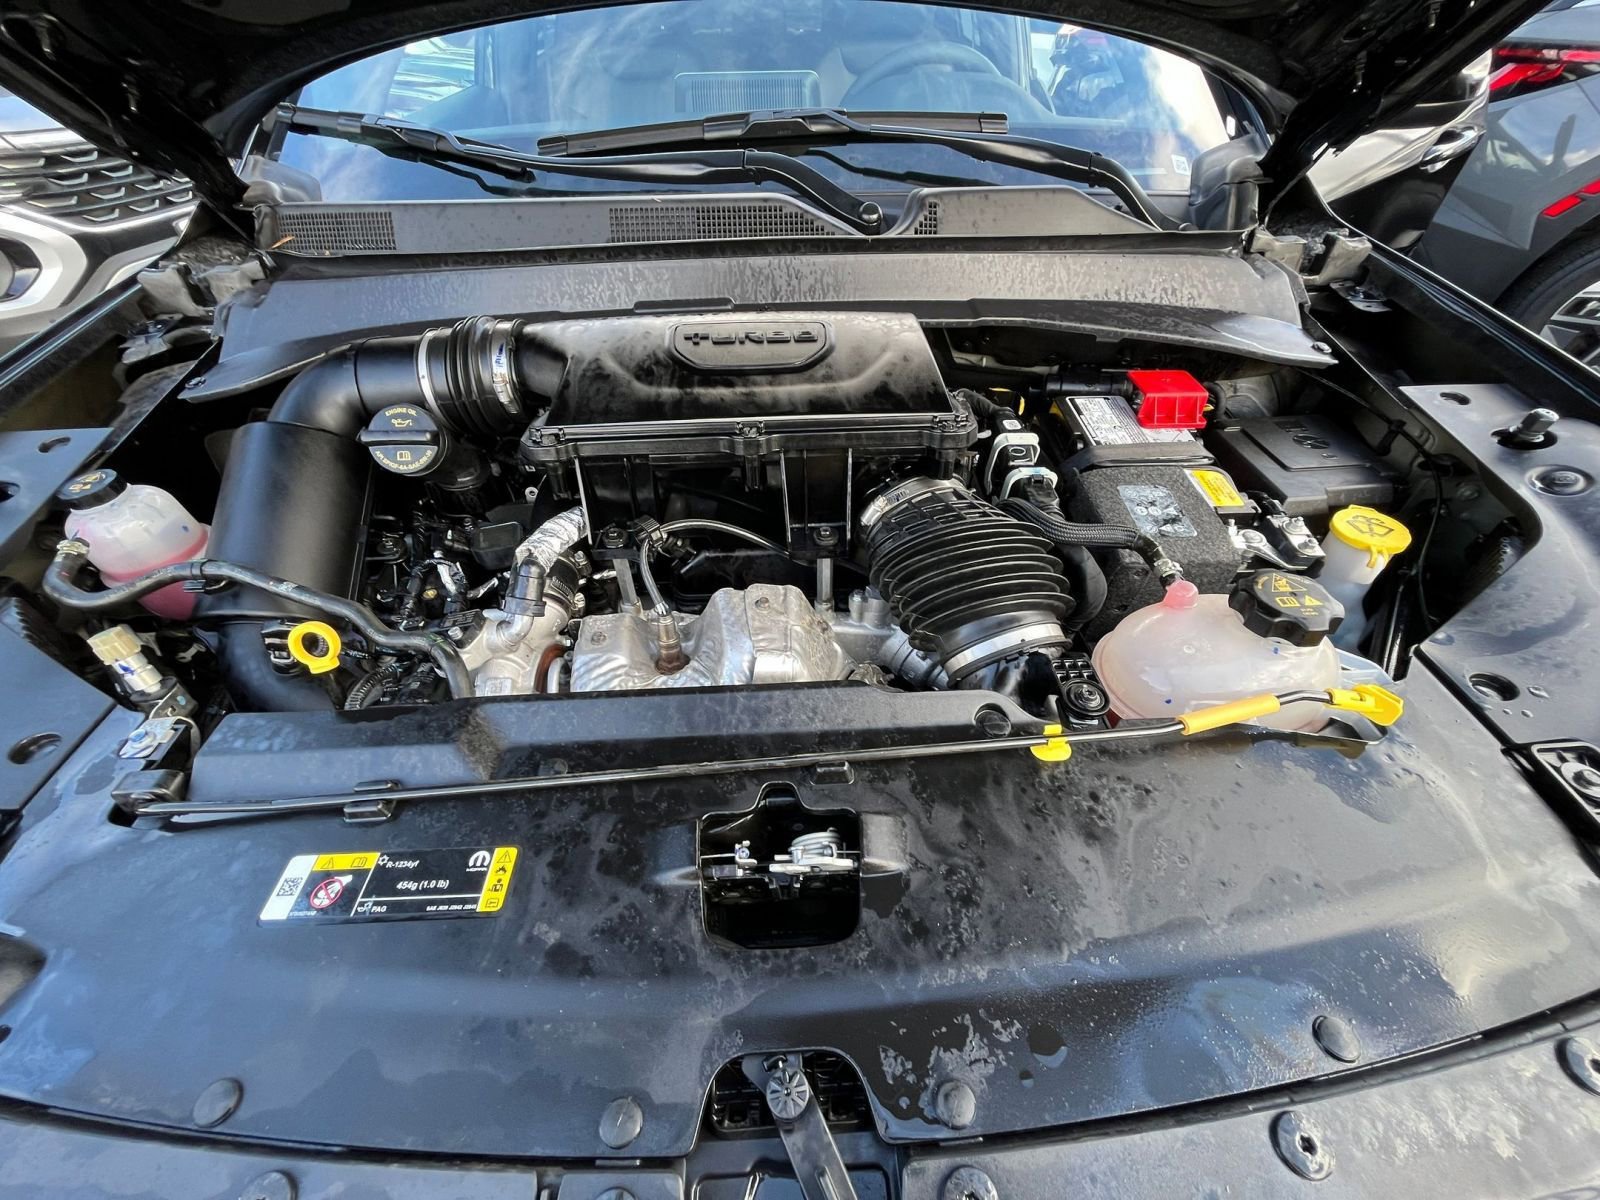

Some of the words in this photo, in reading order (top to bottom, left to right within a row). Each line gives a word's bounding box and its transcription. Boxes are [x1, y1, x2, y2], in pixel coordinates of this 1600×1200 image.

[684, 330, 818, 346] TURBO
[385, 407, 407, 417] ENGINE
[407, 408, 417, 417] OIL
[385, 859, 420, 869] R-1234yf
[396, 880, 419, 891] 454g
[419, 880, 436, 890] (1.0
[436, 879, 450, 889] lb)
[371, 905, 387, 913] PAG
